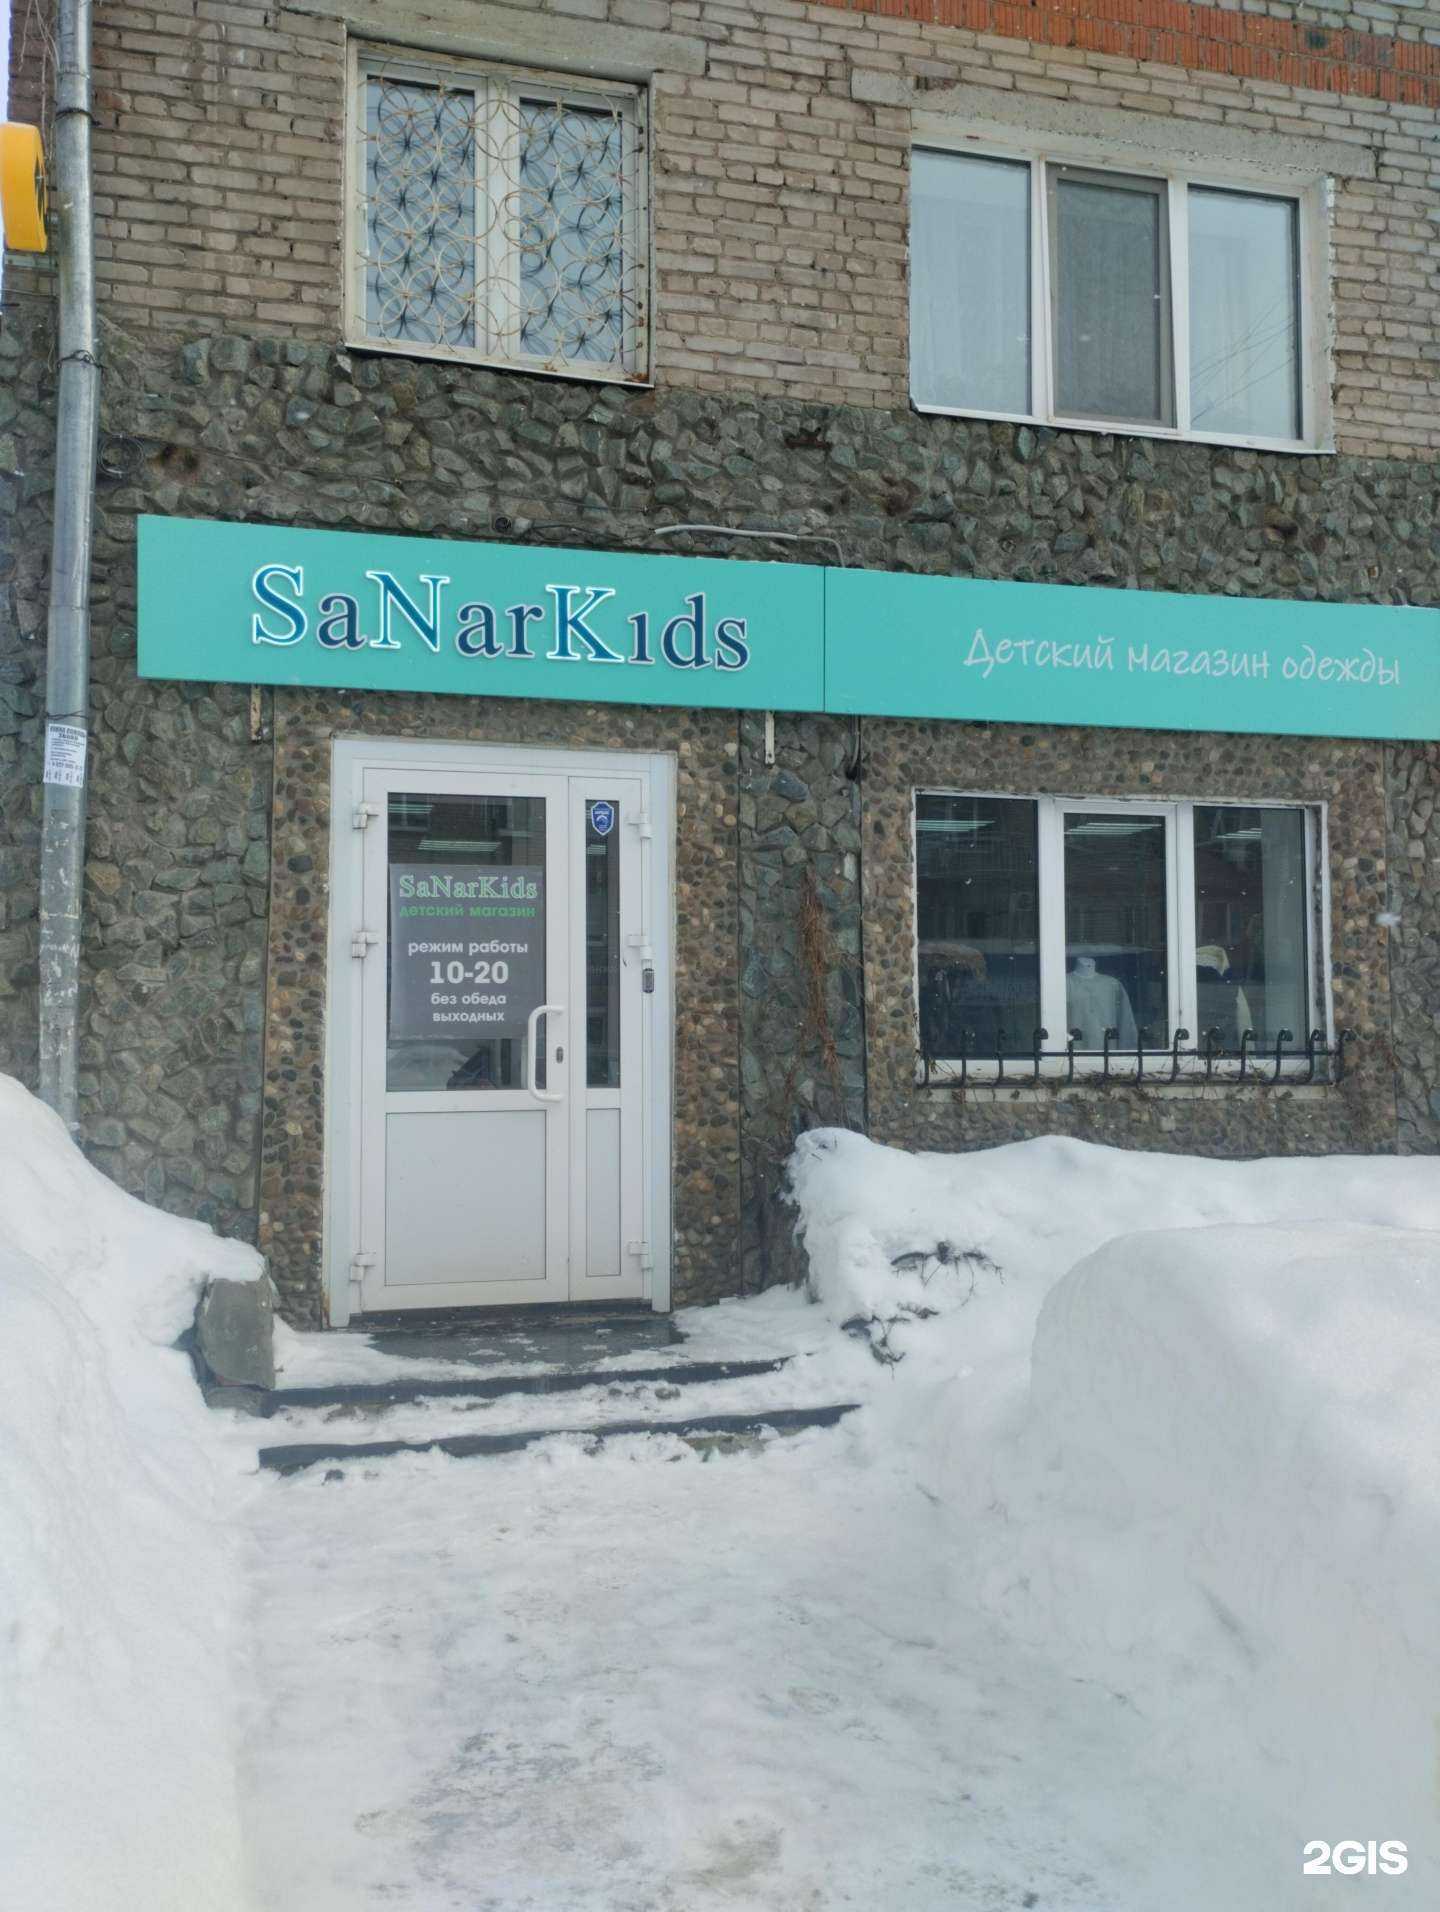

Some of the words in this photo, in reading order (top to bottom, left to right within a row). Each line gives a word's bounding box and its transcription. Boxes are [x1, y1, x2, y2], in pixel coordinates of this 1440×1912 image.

[964, 628, 1114, 679] Детский
[1281, 645, 1401, 686] одежды
[399, 874, 538, 899] SaNarKids
[400, 904, 464, 918] детский
[470, 905, 536, 918] магазин
[408, 942, 463, 957] режим
[469, 940, 529, 956] работы
[430, 960, 509, 984] 10-20
[431, 992, 457, 1005] без
[461, 992, 507, 1006] обеда
[433, 1012, 505, 1023] выходных
